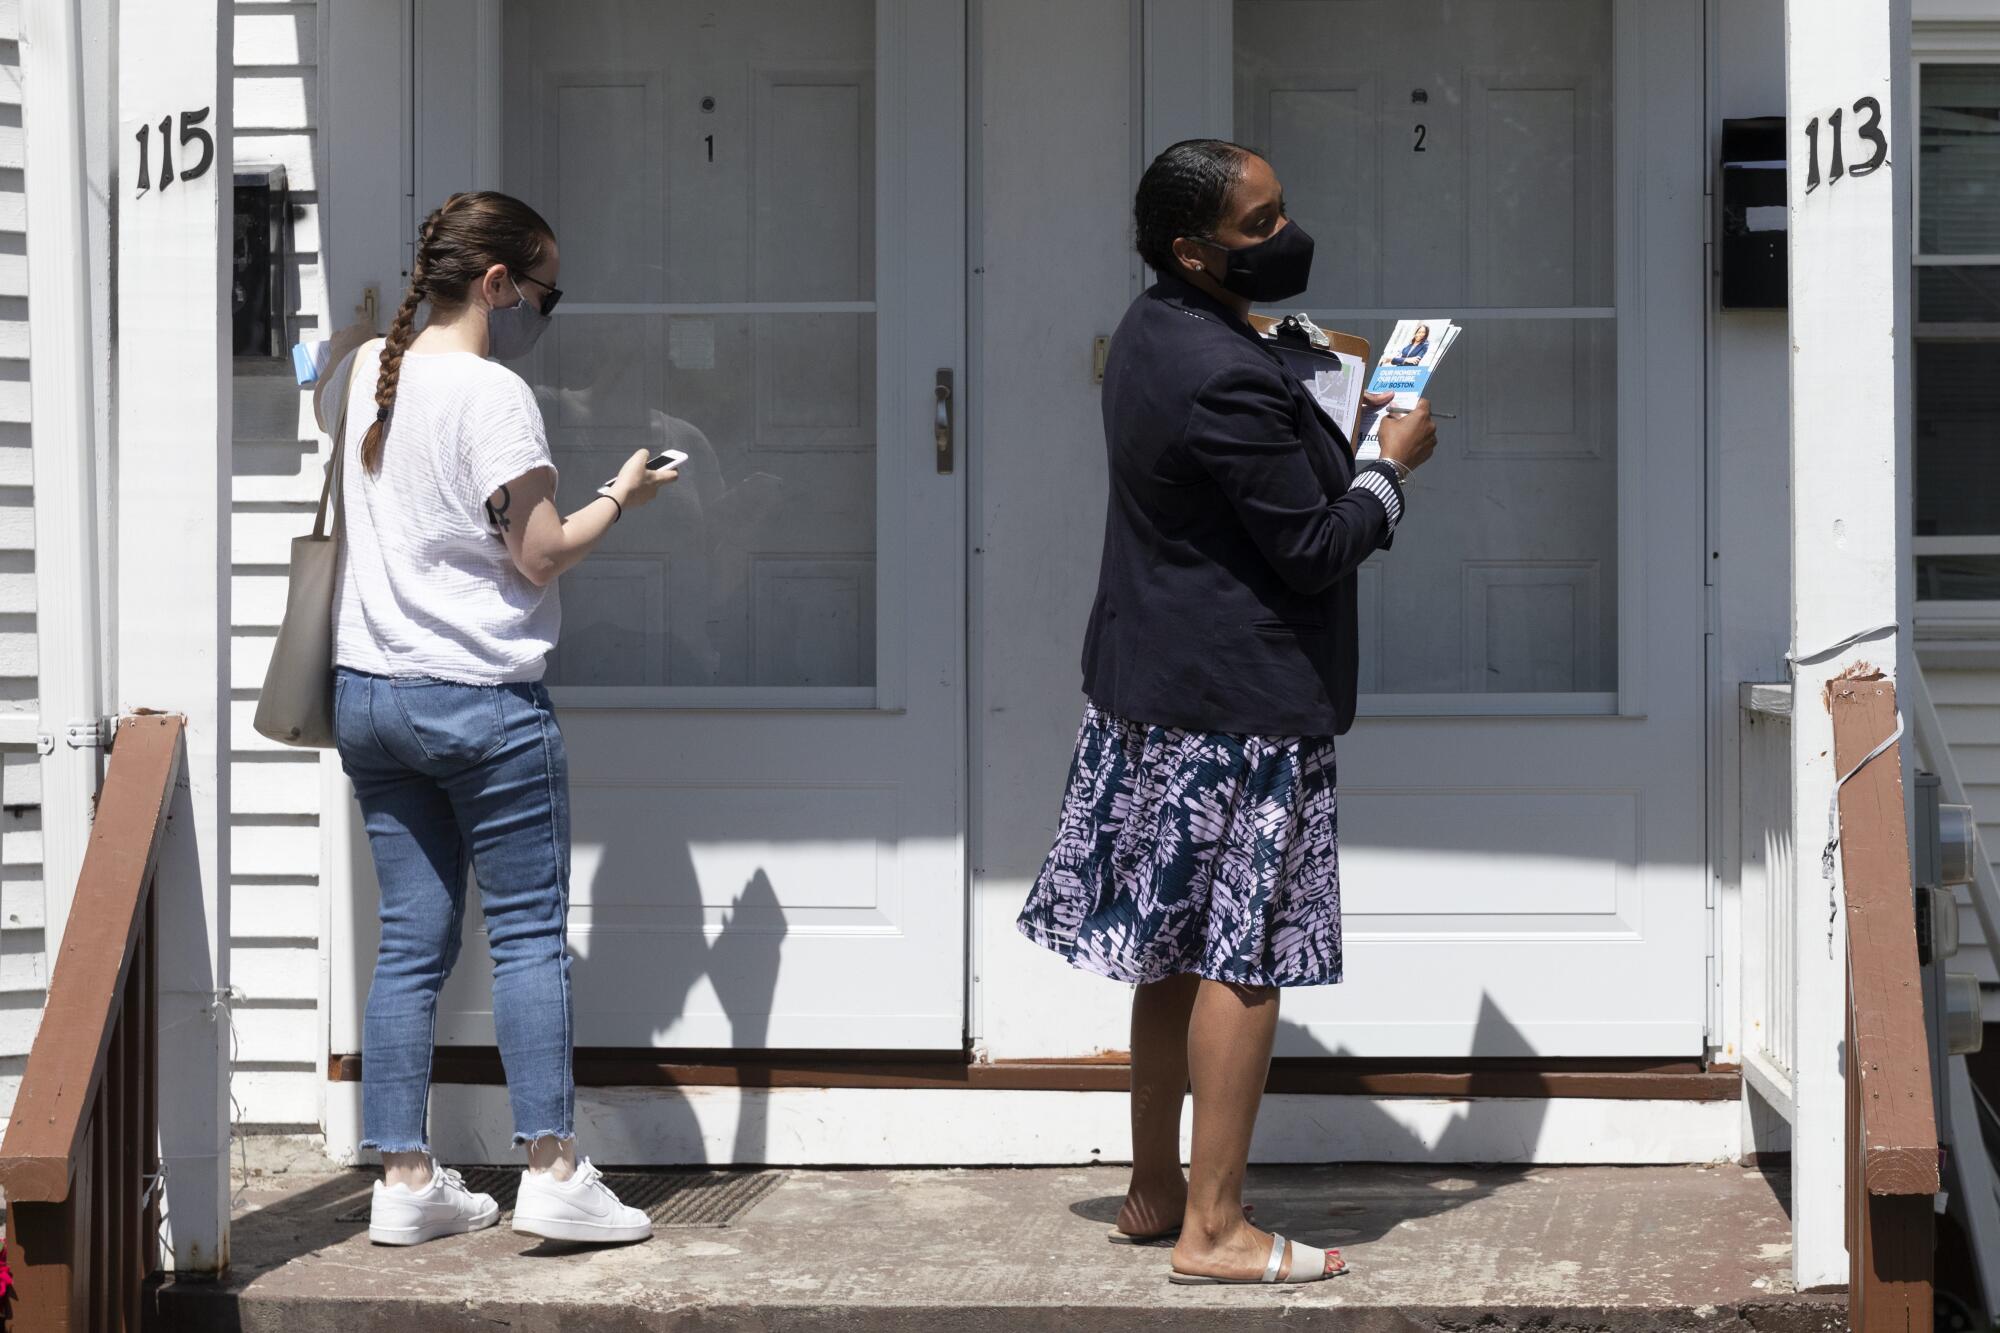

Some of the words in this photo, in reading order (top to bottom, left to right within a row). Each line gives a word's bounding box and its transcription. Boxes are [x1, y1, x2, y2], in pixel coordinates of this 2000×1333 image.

[135, 106, 214, 198] 115
[704, 134, 714, 162] 1
[1414, 124, 1427, 152] 2
[1804, 96, 1887, 194] 113
